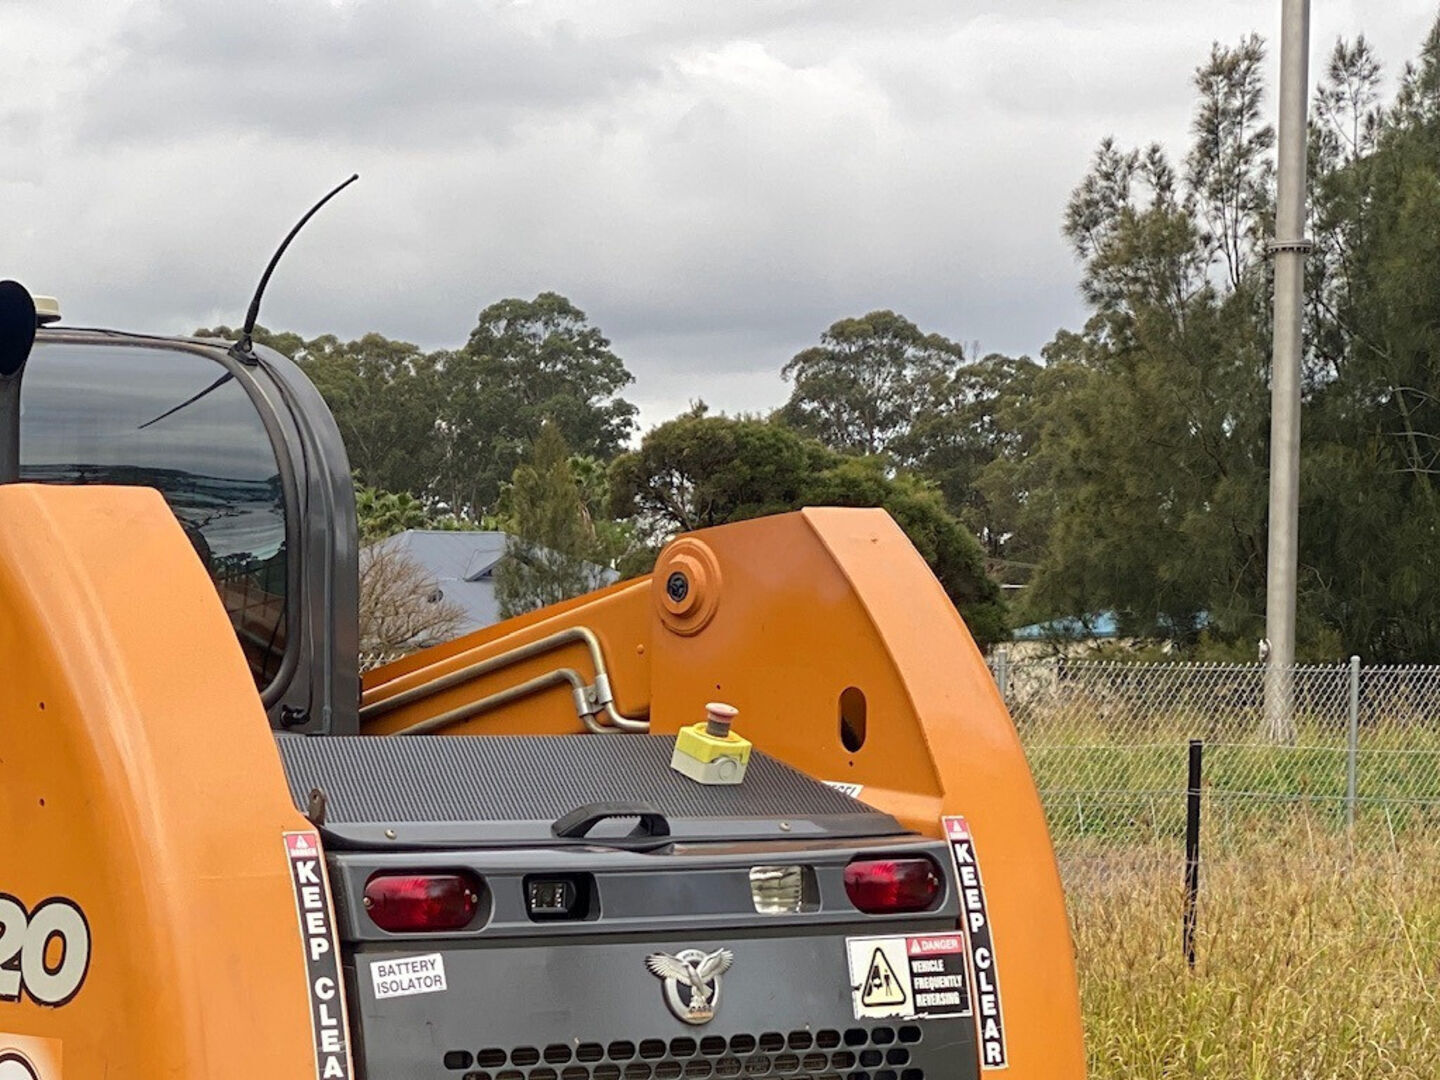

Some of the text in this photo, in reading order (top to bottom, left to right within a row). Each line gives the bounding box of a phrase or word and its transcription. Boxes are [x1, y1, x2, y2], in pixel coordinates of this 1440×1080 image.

[296, 860, 330, 961] KEEP
[921, 938, 959, 952] DANGER
[954, 842, 985, 934] KEEP
[974, 947, 1002, 1064] CLEAR
[377, 958, 437, 978] BATTERY
[910, 958, 945, 973] VEHICLE
[376, 974, 444, 995] ISOLATOR
[913, 974, 963, 990] FREQUENTLY
[915, 991, 961, 1008] REVERSING
